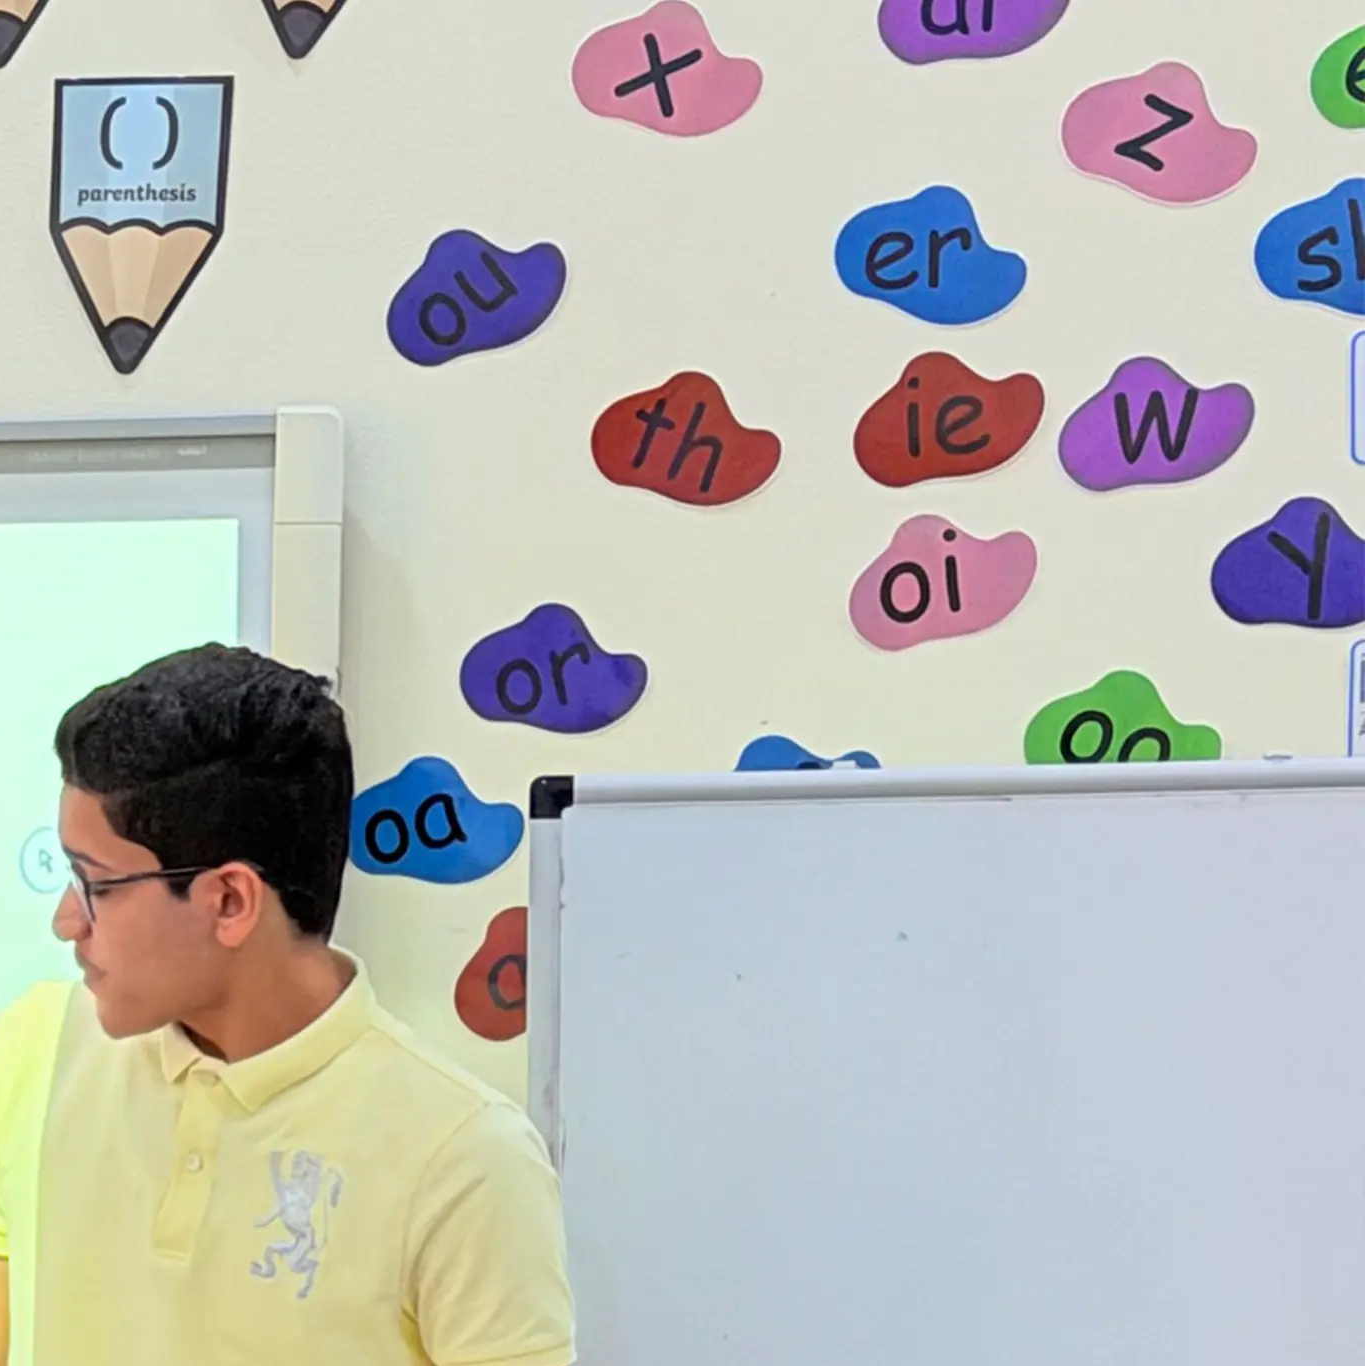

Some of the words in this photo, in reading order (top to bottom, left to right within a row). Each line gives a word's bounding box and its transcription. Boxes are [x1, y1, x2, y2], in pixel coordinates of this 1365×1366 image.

[614, 33, 703, 118] x
[1114, 93, 1194, 172] z
[77, 182, 197, 207] parenthesis
[418, 251, 518, 346] ou
[865, 227, 972, 290] er
[631, 399, 724, 493] th
[907, 376, 991, 458] ie
[880, 528, 961, 623] oi
[495, 642, 590, 715] or
[365, 794, 467, 864] oa
